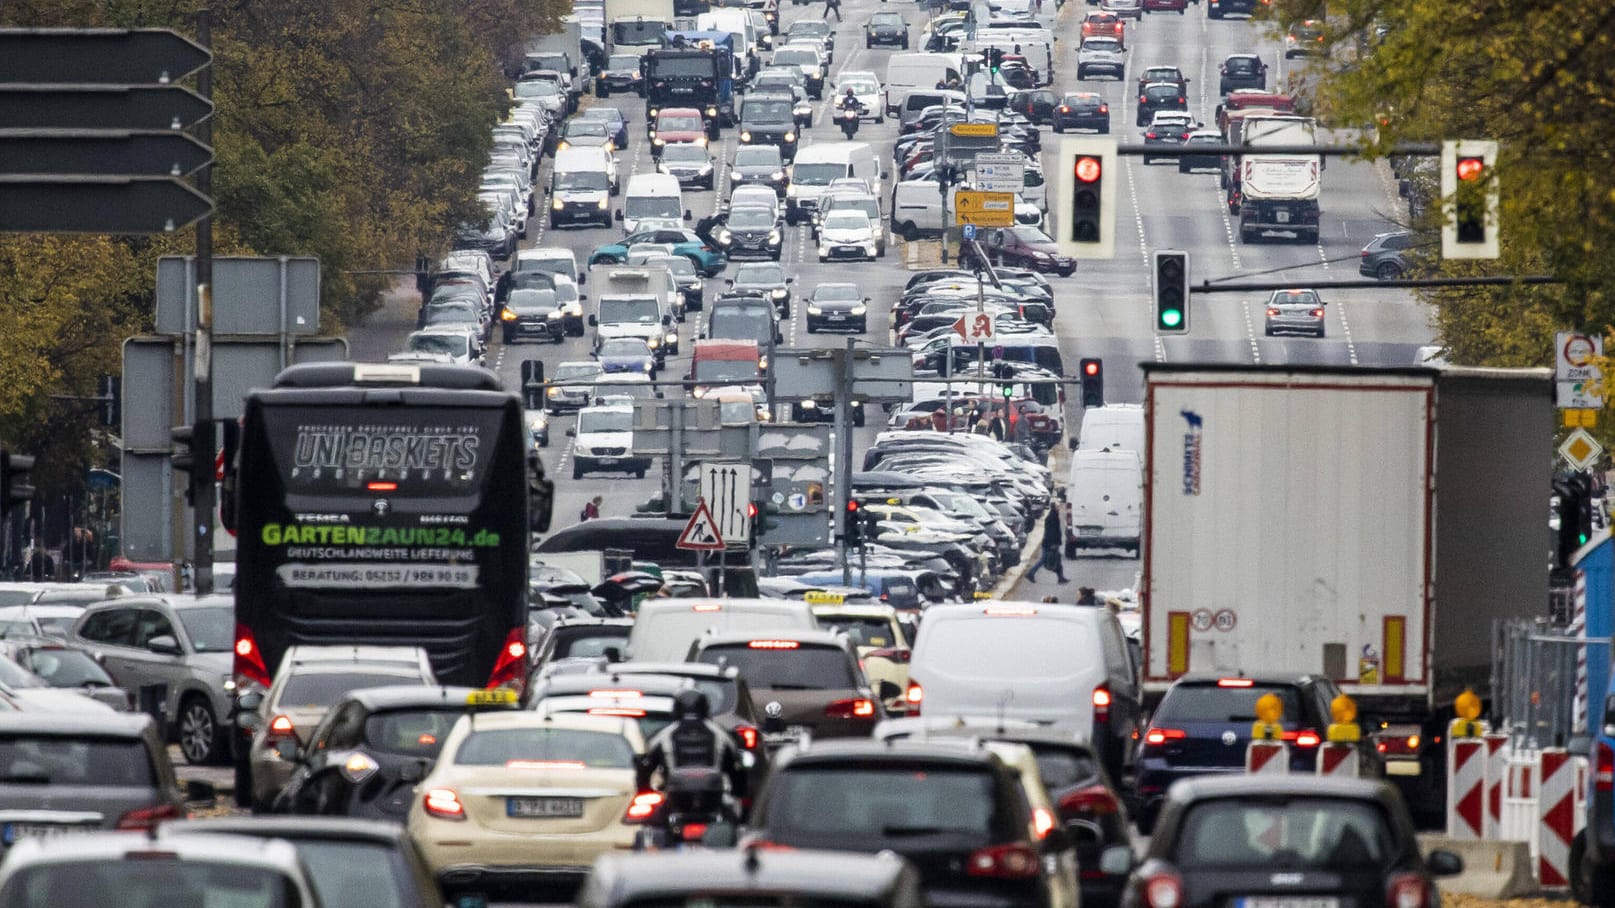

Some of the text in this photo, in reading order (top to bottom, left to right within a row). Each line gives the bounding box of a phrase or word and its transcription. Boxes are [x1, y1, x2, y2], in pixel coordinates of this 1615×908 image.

[295, 432, 480, 470] UNI BASKETS
[261, 522, 501, 547] GARTENZAUN24.de
[287, 547, 474, 561] DEUTSCHLANDWEITE LIEFERUNG
[292, 569, 363, 582] BERATUNG:
